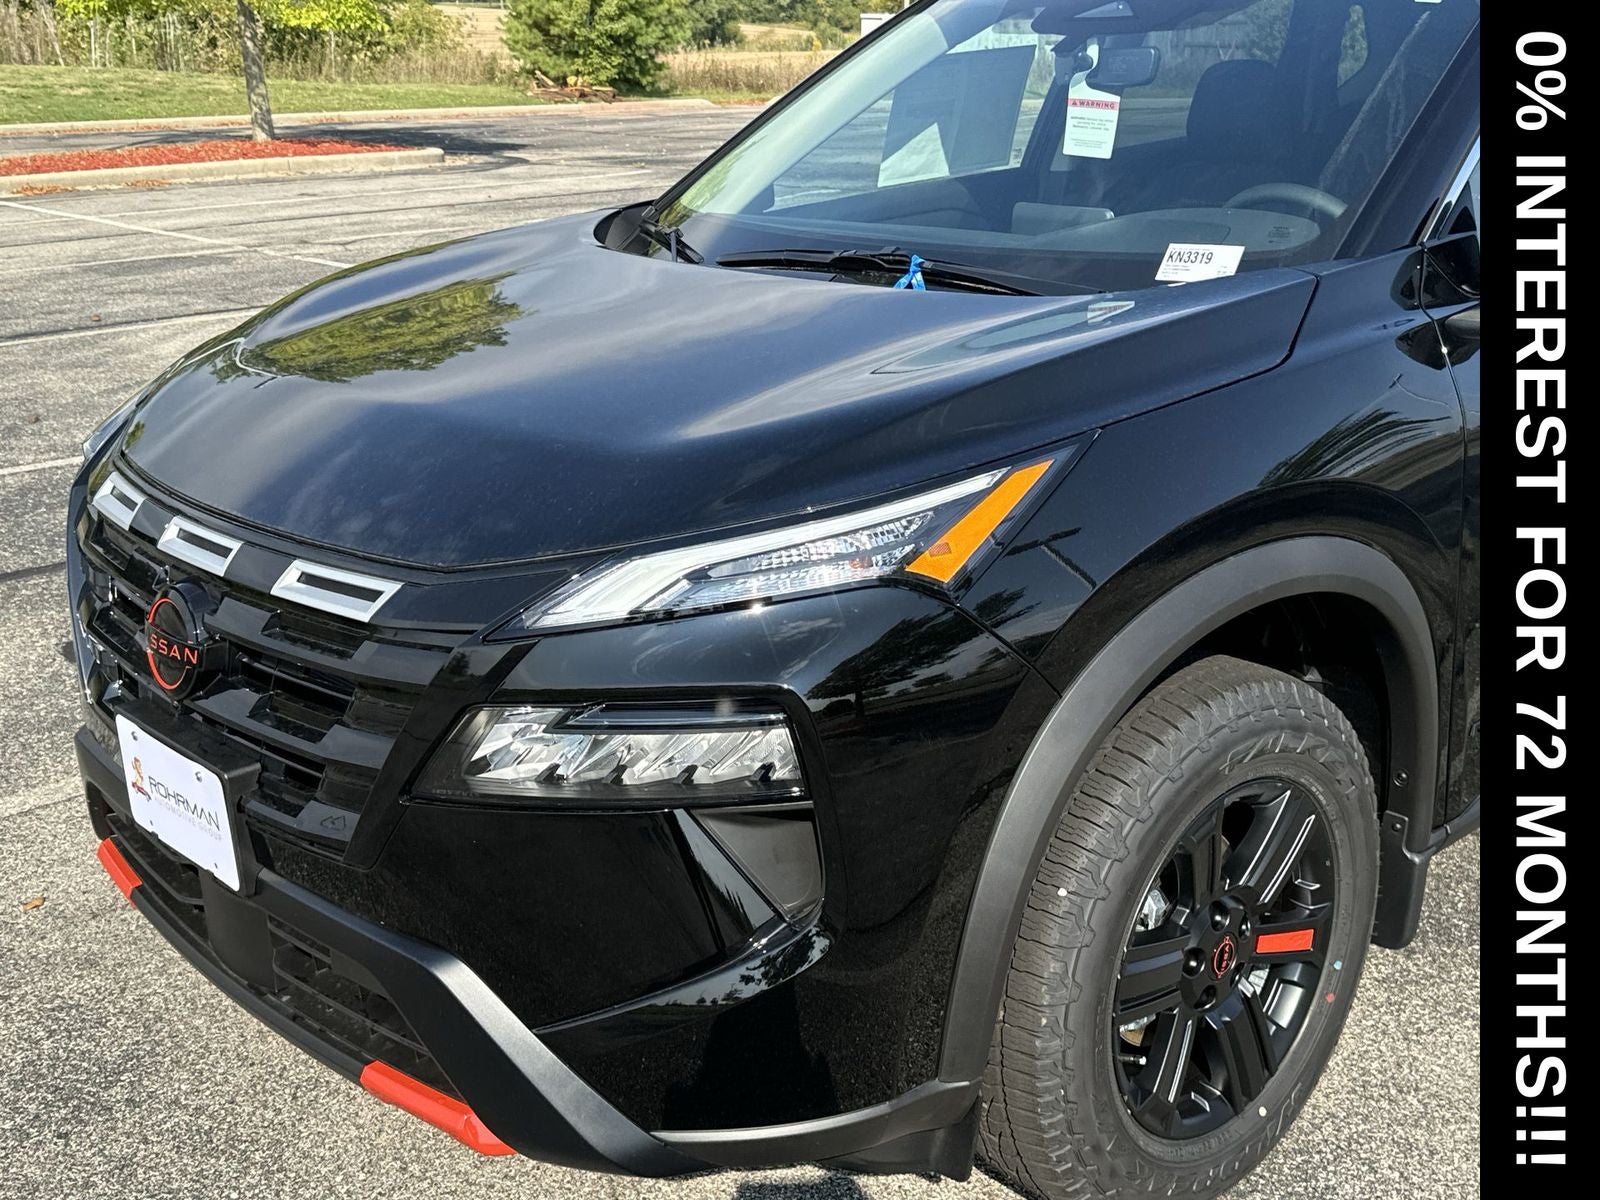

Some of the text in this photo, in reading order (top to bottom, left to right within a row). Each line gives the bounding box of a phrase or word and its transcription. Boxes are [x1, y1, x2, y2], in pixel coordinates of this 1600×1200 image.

[1079, 101, 1115, 110] WARNING
[1166, 250, 1214, 265] KN3319
[148, 775, 220, 832] ROHRMAN
